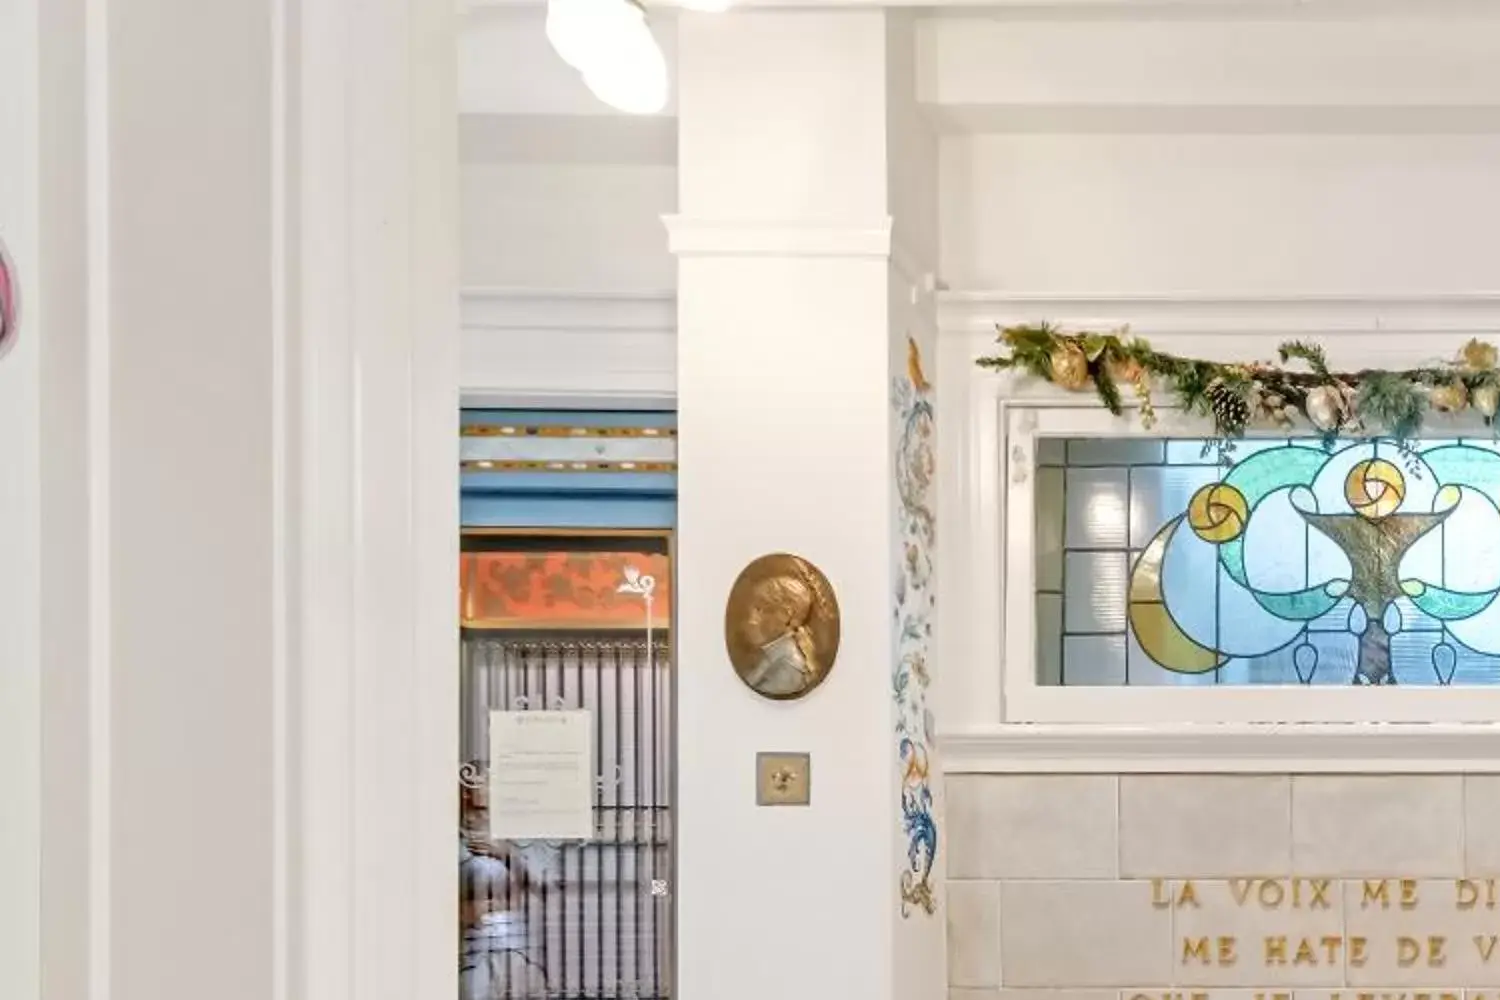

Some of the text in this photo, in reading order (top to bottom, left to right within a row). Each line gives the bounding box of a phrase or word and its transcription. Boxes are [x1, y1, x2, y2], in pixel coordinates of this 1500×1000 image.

[1150, 878, 1198, 907] LA
[1230, 878, 1331, 907] VOIX
[1361, 878, 1419, 907] ME
[1181, 934, 1237, 966] ME
[1264, 934, 1369, 965] HATE
[1397, 935, 1447, 964] DE
